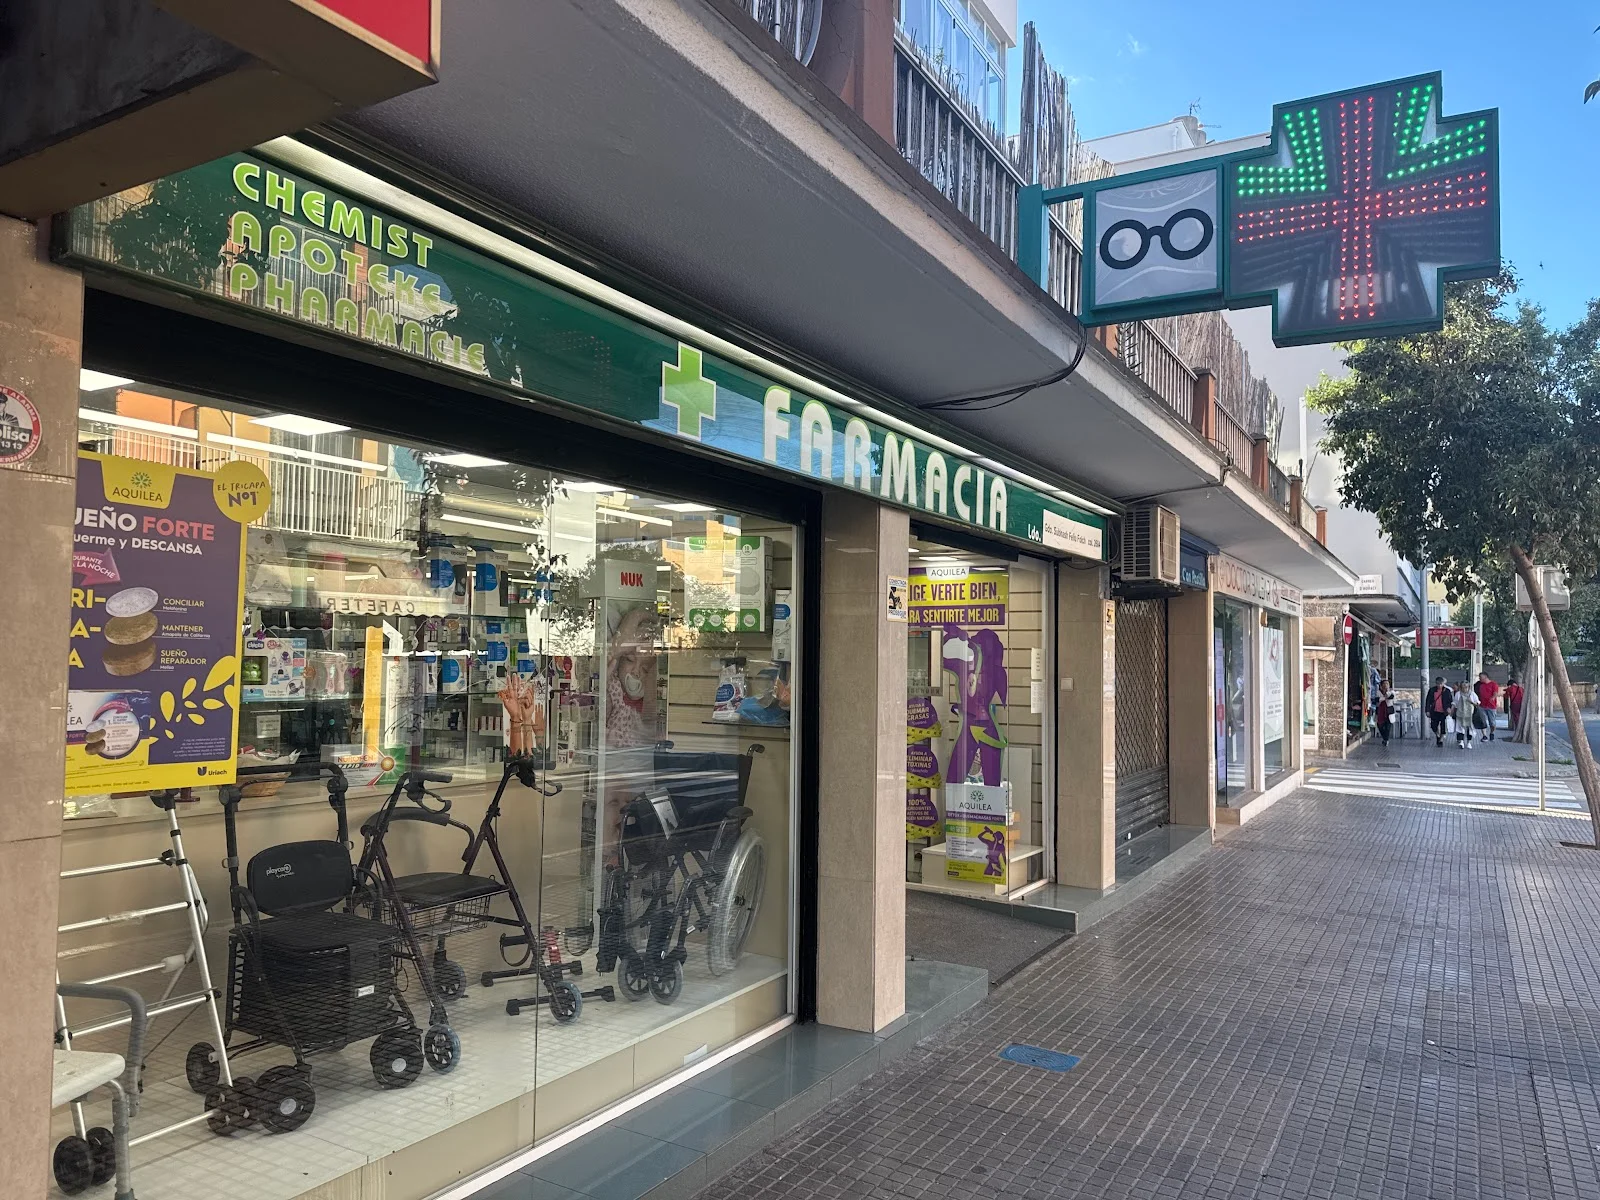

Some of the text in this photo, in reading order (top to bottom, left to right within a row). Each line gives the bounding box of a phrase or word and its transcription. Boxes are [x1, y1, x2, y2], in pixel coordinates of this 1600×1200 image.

[233, 162, 433, 267] CHEMIST
[231, 211, 442, 314] APOTEKE
[230, 263, 485, 372] PHARMACIE
[11, 392, 37, 422] ALARMA
[0, 440, 22, 450] 13 13
[763, 385, 1008, 533] FARMACIA
[217, 481, 266, 491] EL TRICAPA
[112, 487, 163, 503] AQUILEA
[143, 516, 215, 541] FORTE
[1027, 523, 1041, 542] Ldo.
[119, 538, 128, 550] y
[131, 538, 203, 555] DESCANSA
[88, 562, 116, 579] NOCHE
[931, 568, 966, 577] AQUILEA
[621, 571, 643, 587] NUK
[908, 582, 1000, 601] IGE VERTE BIEN,
[163, 598, 205, 607] CONCILIAR
[923, 608, 965, 623] SENTIRTE
[968, 608, 999, 622] MEJOR
[162, 625, 204, 633] MANTENER
[161, 648, 188, 657] SUEÑO
[160, 657, 207, 665] REPARADOR
[907, 798, 926, 806] 100%
[959, 802, 992, 811] AQUILEA
